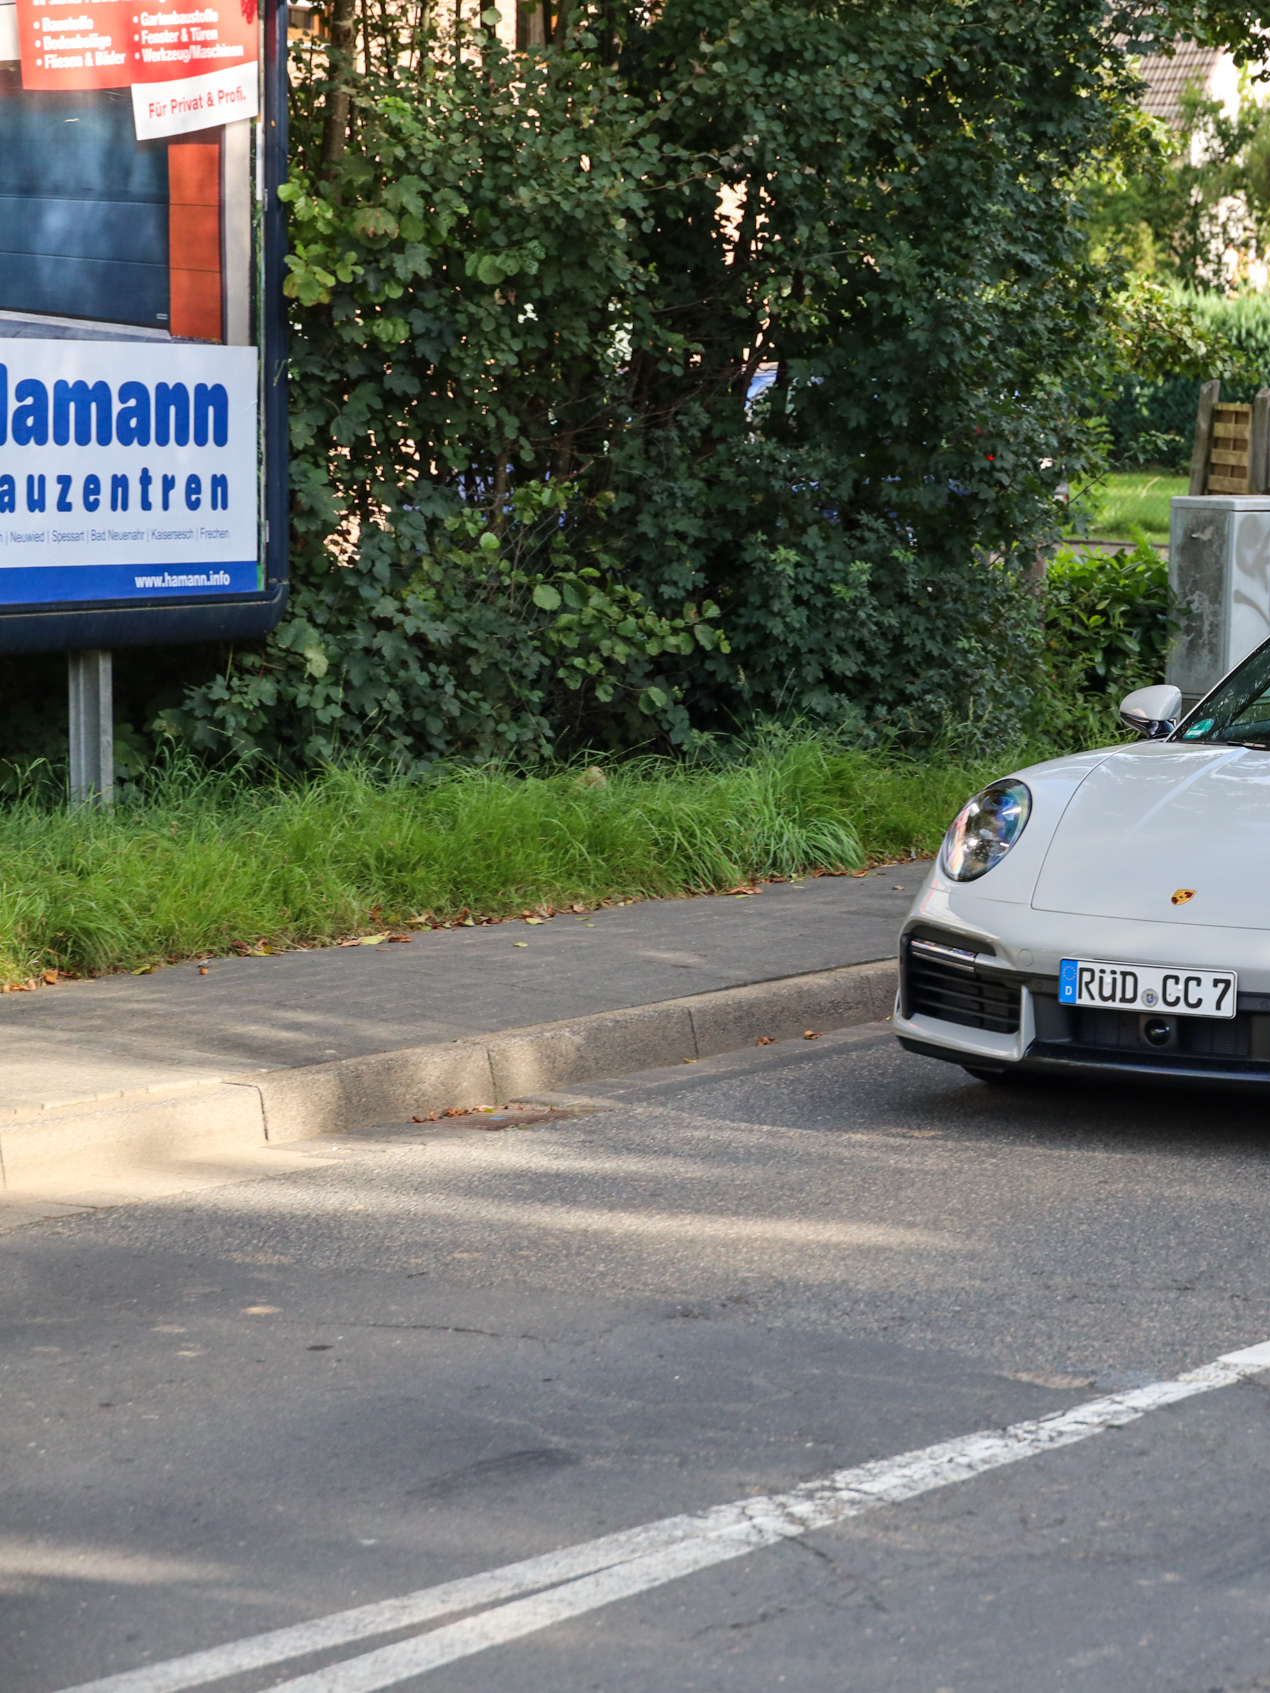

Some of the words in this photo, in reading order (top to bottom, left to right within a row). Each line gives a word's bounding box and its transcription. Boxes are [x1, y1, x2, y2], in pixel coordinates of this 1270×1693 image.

[42, 15, 94, 32] Baustoffe
[140, 8, 219, 26] Gartenbaustoffe
[43, 33, 112, 50] Bodenbeläge
[141, 29, 179, 44] Fenster
[181, 28, 189, 42] &
[190, 27, 218, 41] Türen
[44, 54, 83, 69] Fliesen
[84, 51, 94, 67] &
[95, 50, 126, 66] Bäder
[141, 43, 244, 63] Werkzeug/Maschinen
[148, 101, 167, 118] Für
[170, 93, 203, 114] Privat
[206, 91, 215, 108] &
[217, 86, 247, 105] Profi.
[0, 362, 229, 447] amann
[9, 531, 45, 543] Neuwied
[51, 529, 85, 545] Spessart
[91, 529, 106, 541] Bad
[107, 528, 145, 541] Neuenahr
[151, 528, 194, 541] Kaisersesch
[199, 527, 229, 539] Frechen
[134, 570, 230, 588] www.hamann.info
[1064, 985, 1073, 996] D
[1078, 967, 1138, 1004] RÜD
[1162, 974, 1203, 1009] CC
[1213, 978, 1232, 1011] 7
